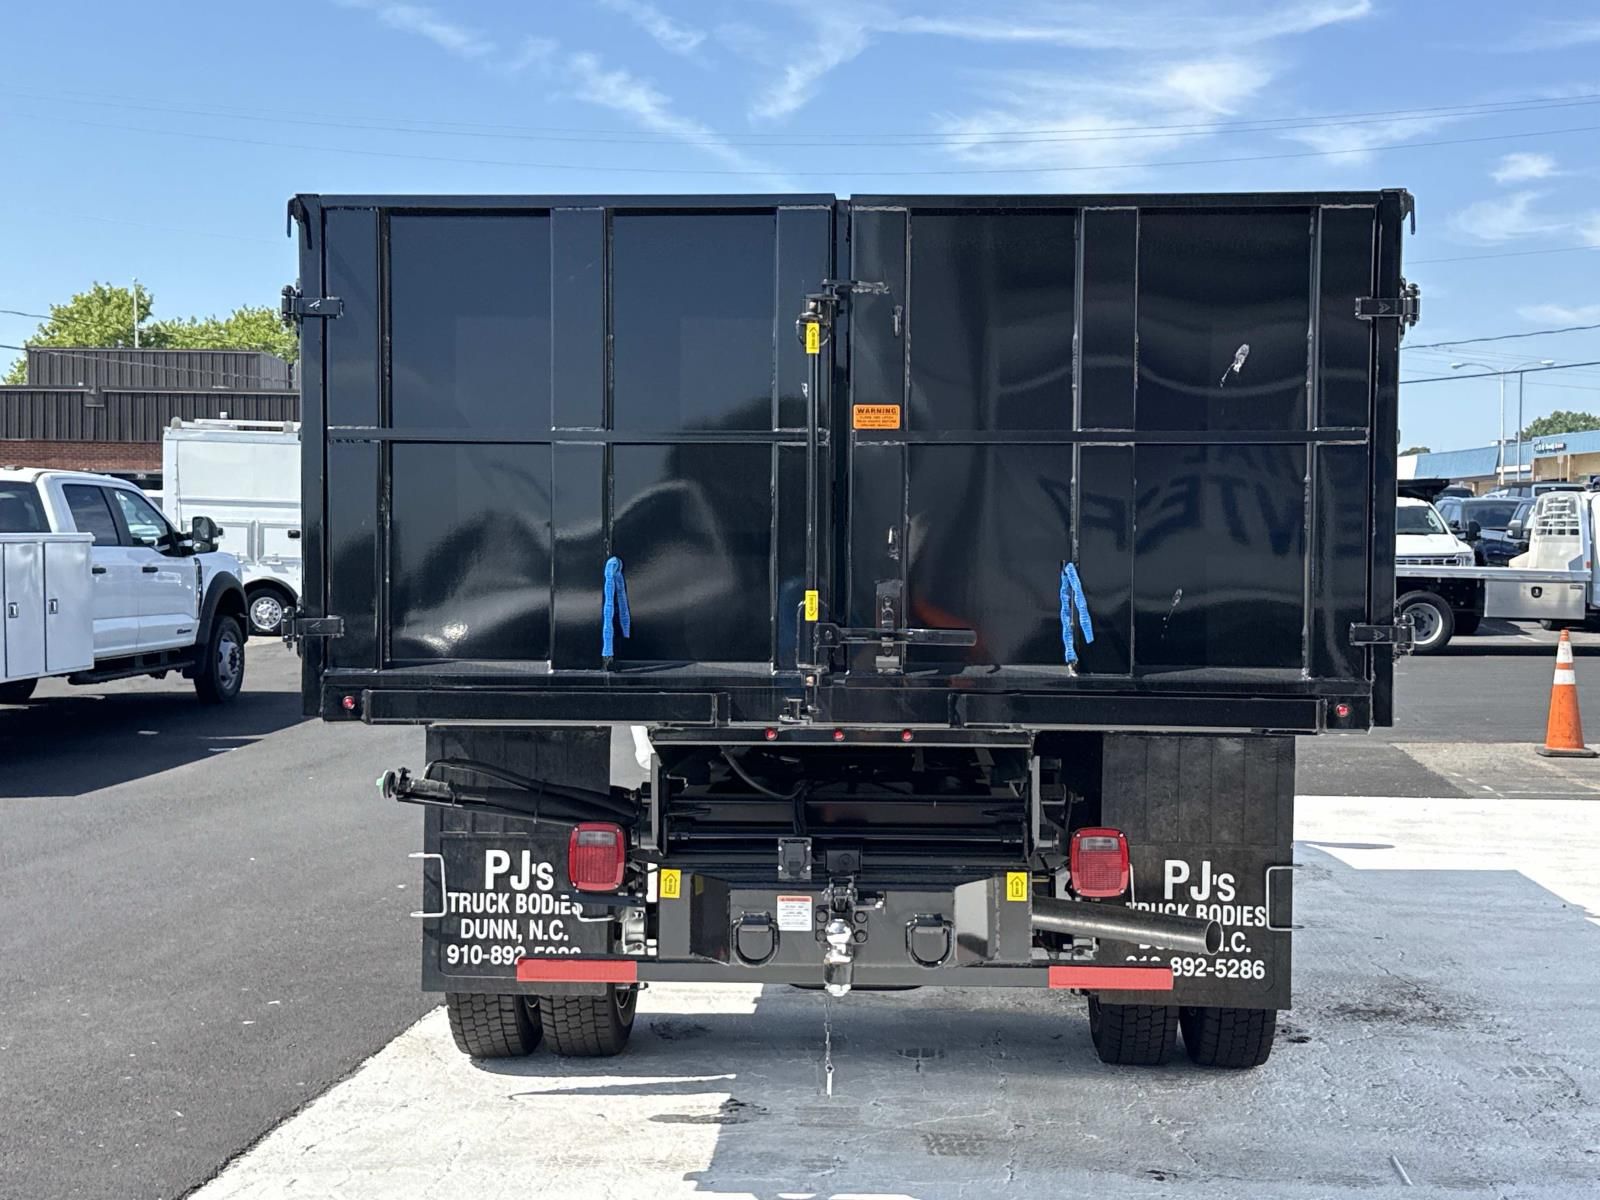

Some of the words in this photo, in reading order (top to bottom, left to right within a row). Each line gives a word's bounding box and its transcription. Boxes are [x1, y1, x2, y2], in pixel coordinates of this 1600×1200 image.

[447, 892, 510, 914] TRUCK
[1196, 903, 1266, 927] BODIES
[460, 918, 523, 943] DUNN,
[529, 919, 569, 941] N.C.
[446, 944, 582, 966] 910-892
